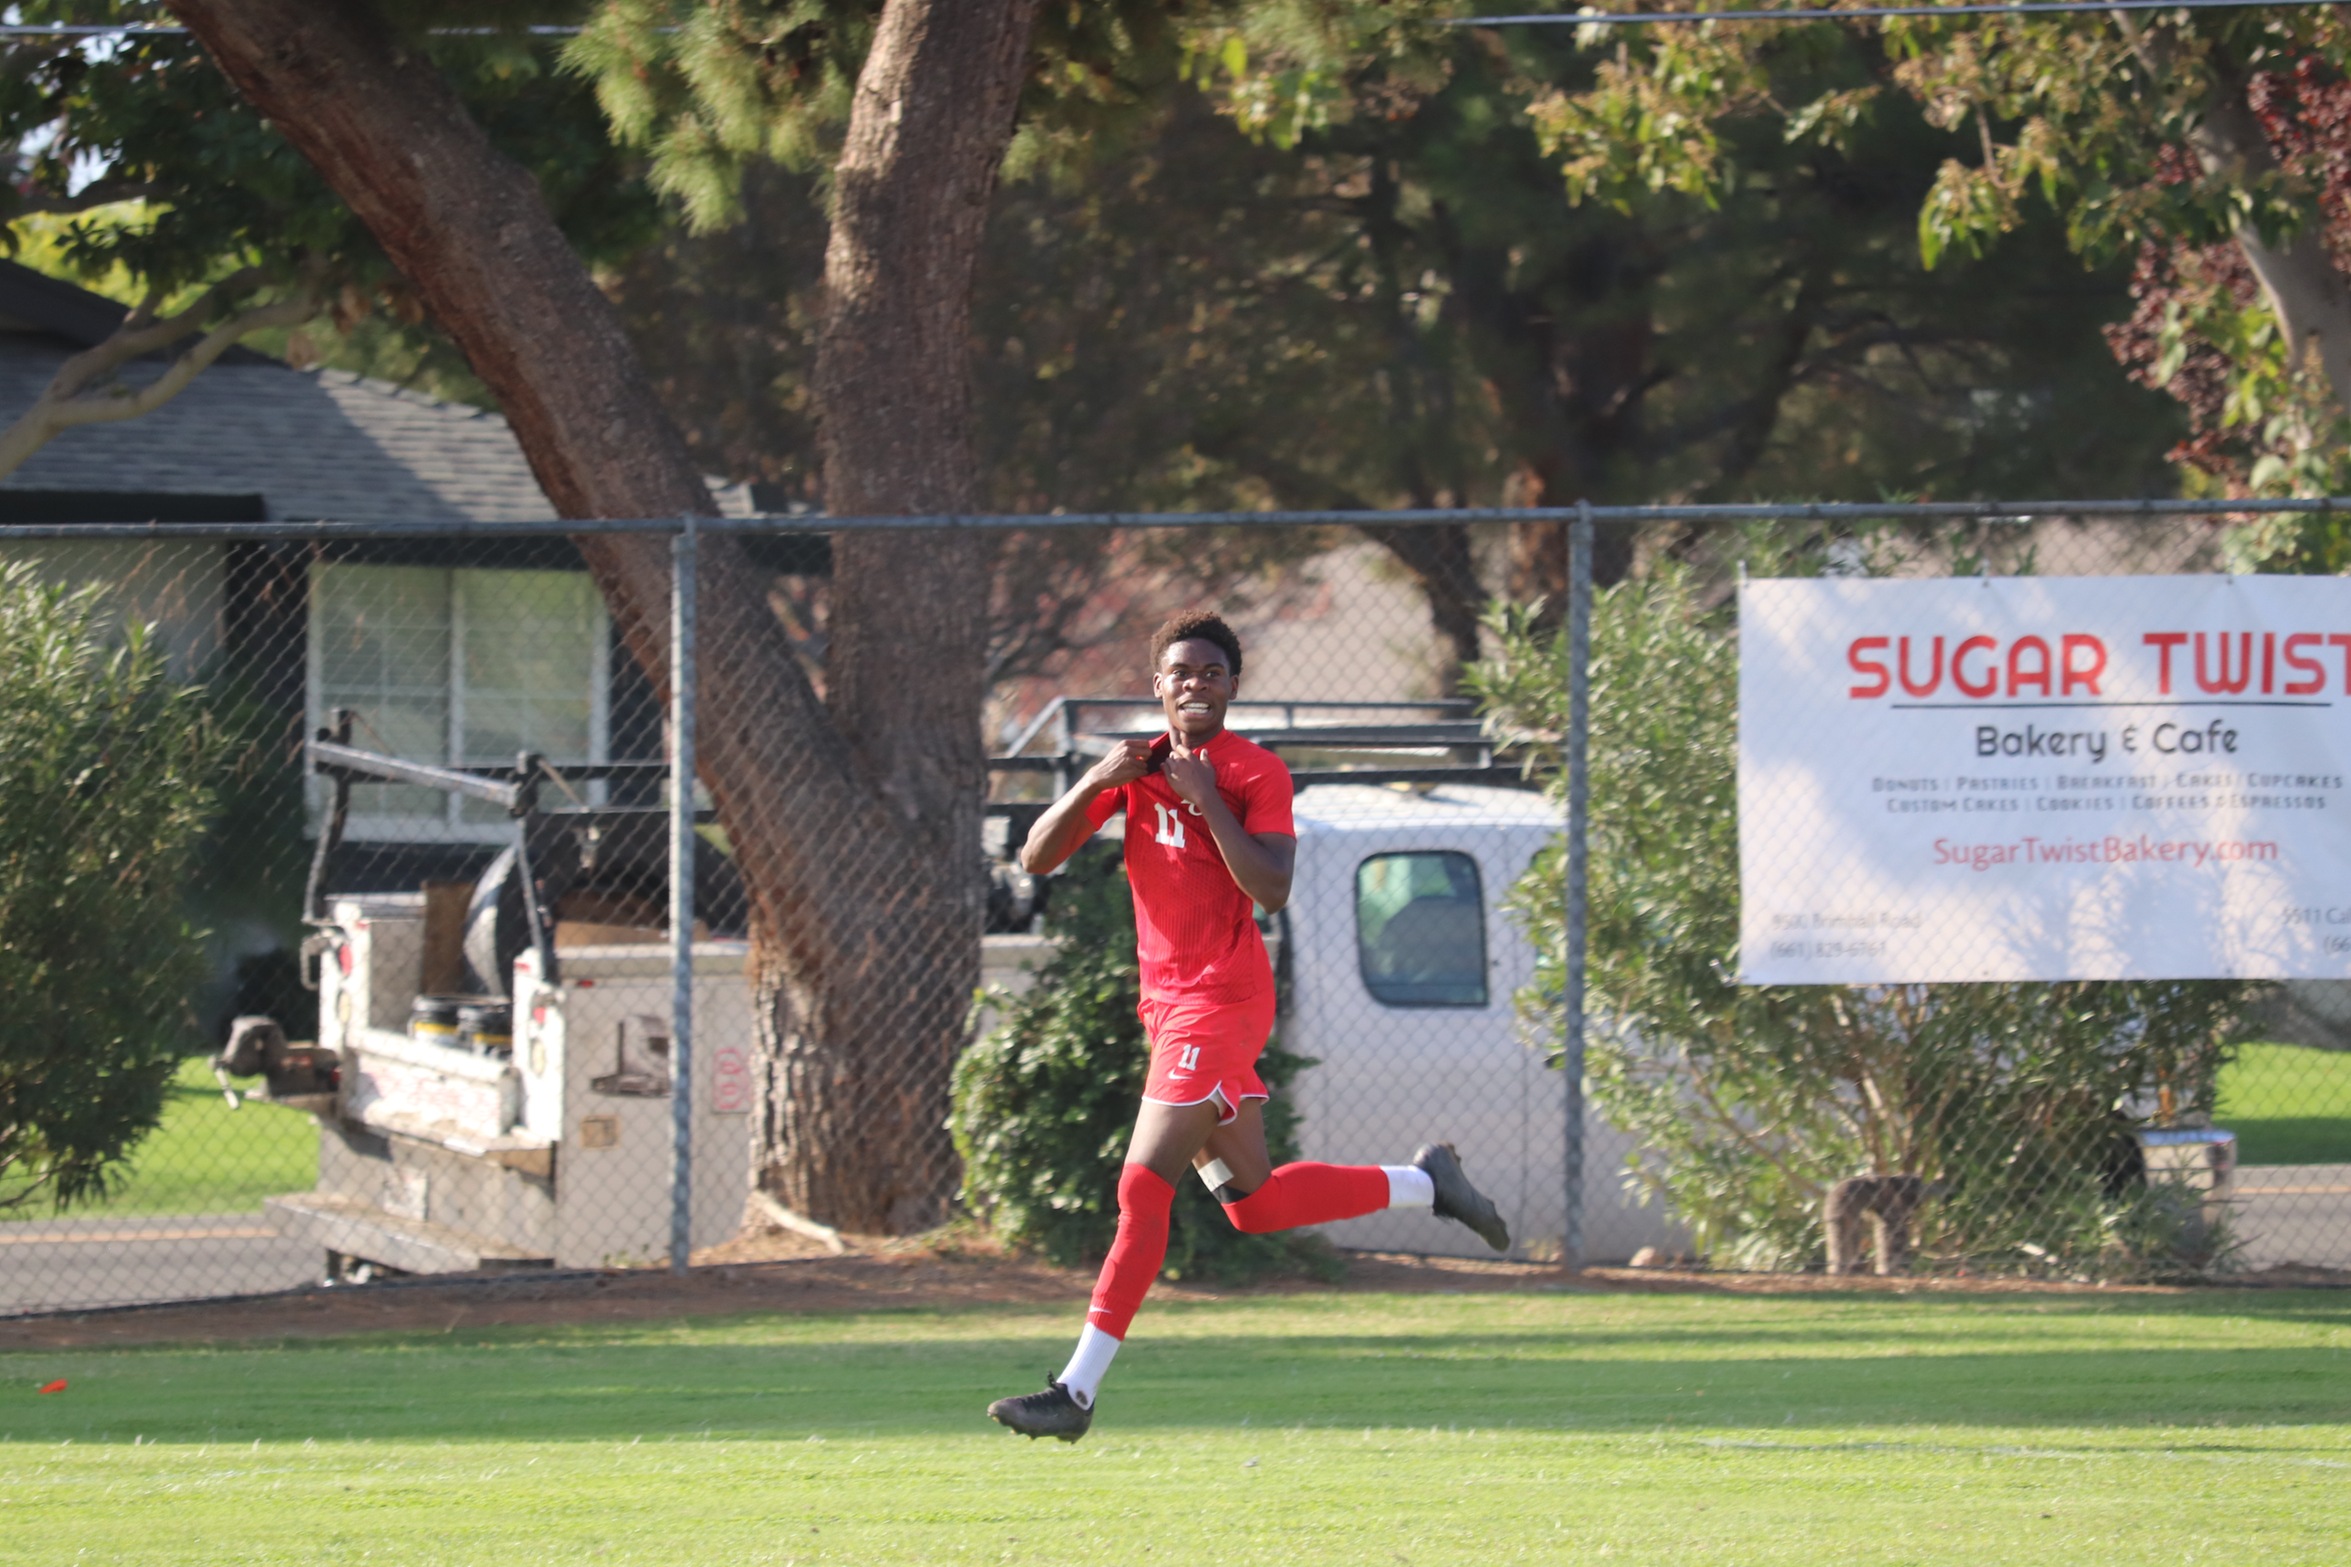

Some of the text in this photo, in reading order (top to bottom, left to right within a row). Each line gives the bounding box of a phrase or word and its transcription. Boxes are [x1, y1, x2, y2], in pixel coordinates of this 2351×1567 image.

[1847, 631, 2351, 699] SUGAR TWIST
[1975, 724, 2106, 763] Bakery
[2152, 719, 2240, 756] Cafe
[1154, 802, 1186, 849] 11
[1933, 835, 2278, 871] SugarTwistBakery.com
[1178, 1043, 1200, 1072] 11
